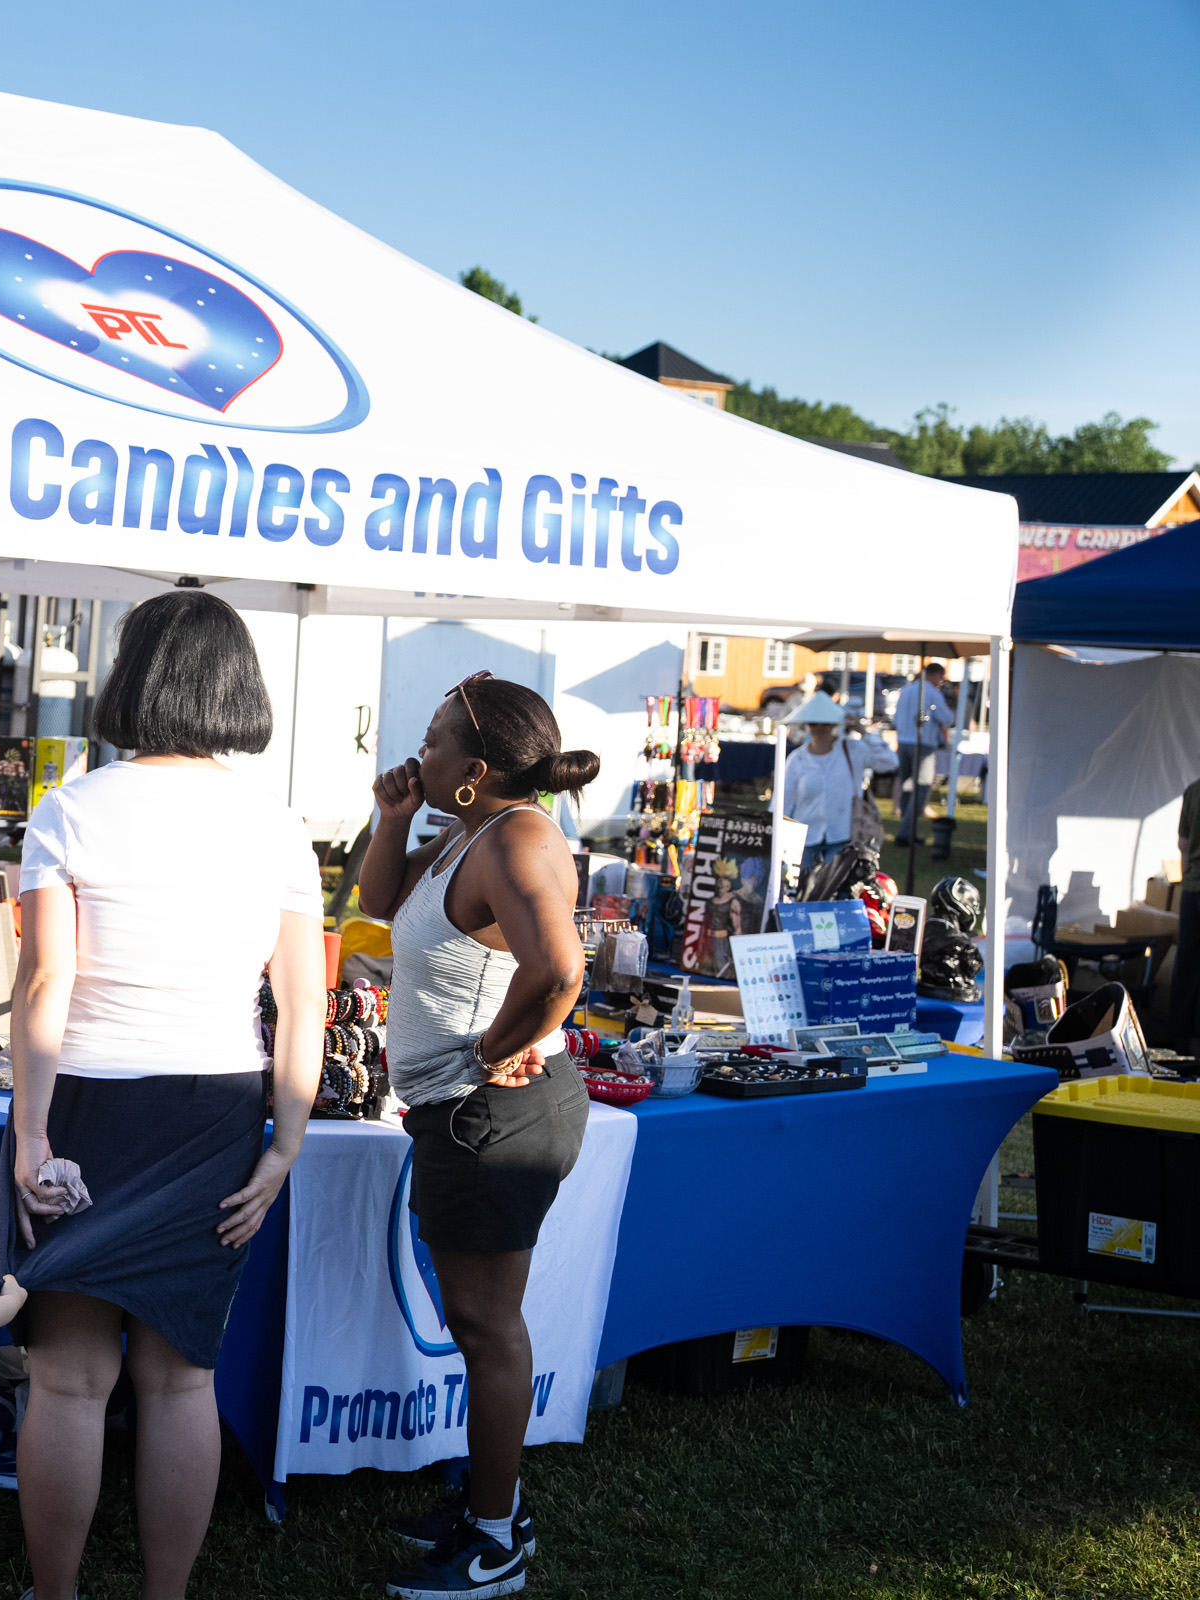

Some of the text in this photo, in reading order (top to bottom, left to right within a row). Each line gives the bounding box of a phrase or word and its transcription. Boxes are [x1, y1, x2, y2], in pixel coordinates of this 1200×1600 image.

[80, 303, 189, 350] PTL
[9, 417, 351, 547] Candles
[363, 467, 503, 560] and
[520, 472, 683, 576] Gifts
[1019, 526, 1071, 548] WEET
[700, 816, 726, 830] FUTURE
[682, 830, 723, 969] TRUNKS
[1092, 1215, 1113, 1226] HDX
[300, 1378, 437, 1444] Promote
